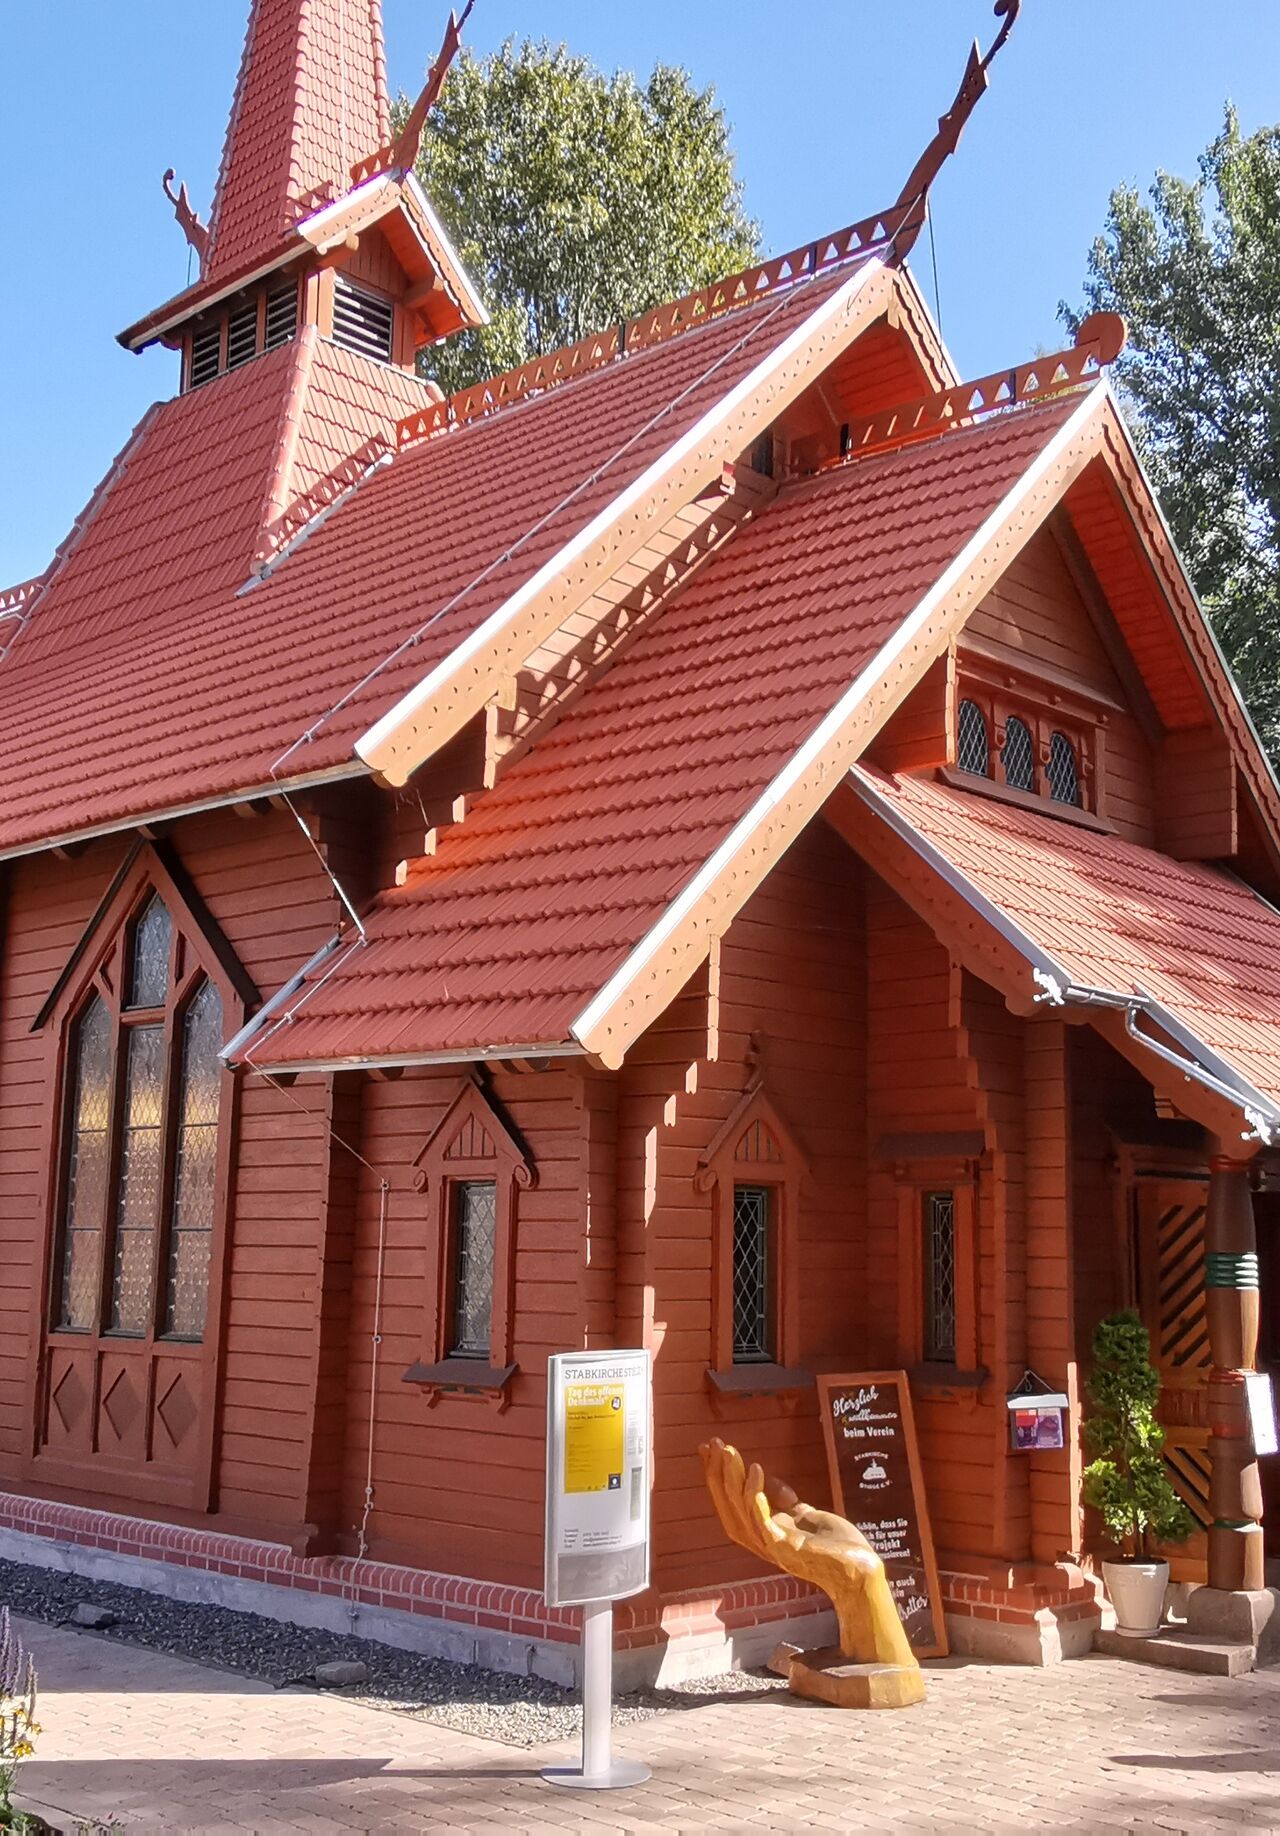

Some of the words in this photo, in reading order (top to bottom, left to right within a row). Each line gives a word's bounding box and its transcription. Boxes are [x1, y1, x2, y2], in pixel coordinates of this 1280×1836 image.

[833, 1385, 879, 1417] Herzlich
[843, 1427, 865, 1438] beim
[866, 1426, 895, 1437] Verein
[880, 1519, 896, 1529] dass
[896, 1518, 908, 1527] Sie
[895, 1575, 916, 1588] auch
